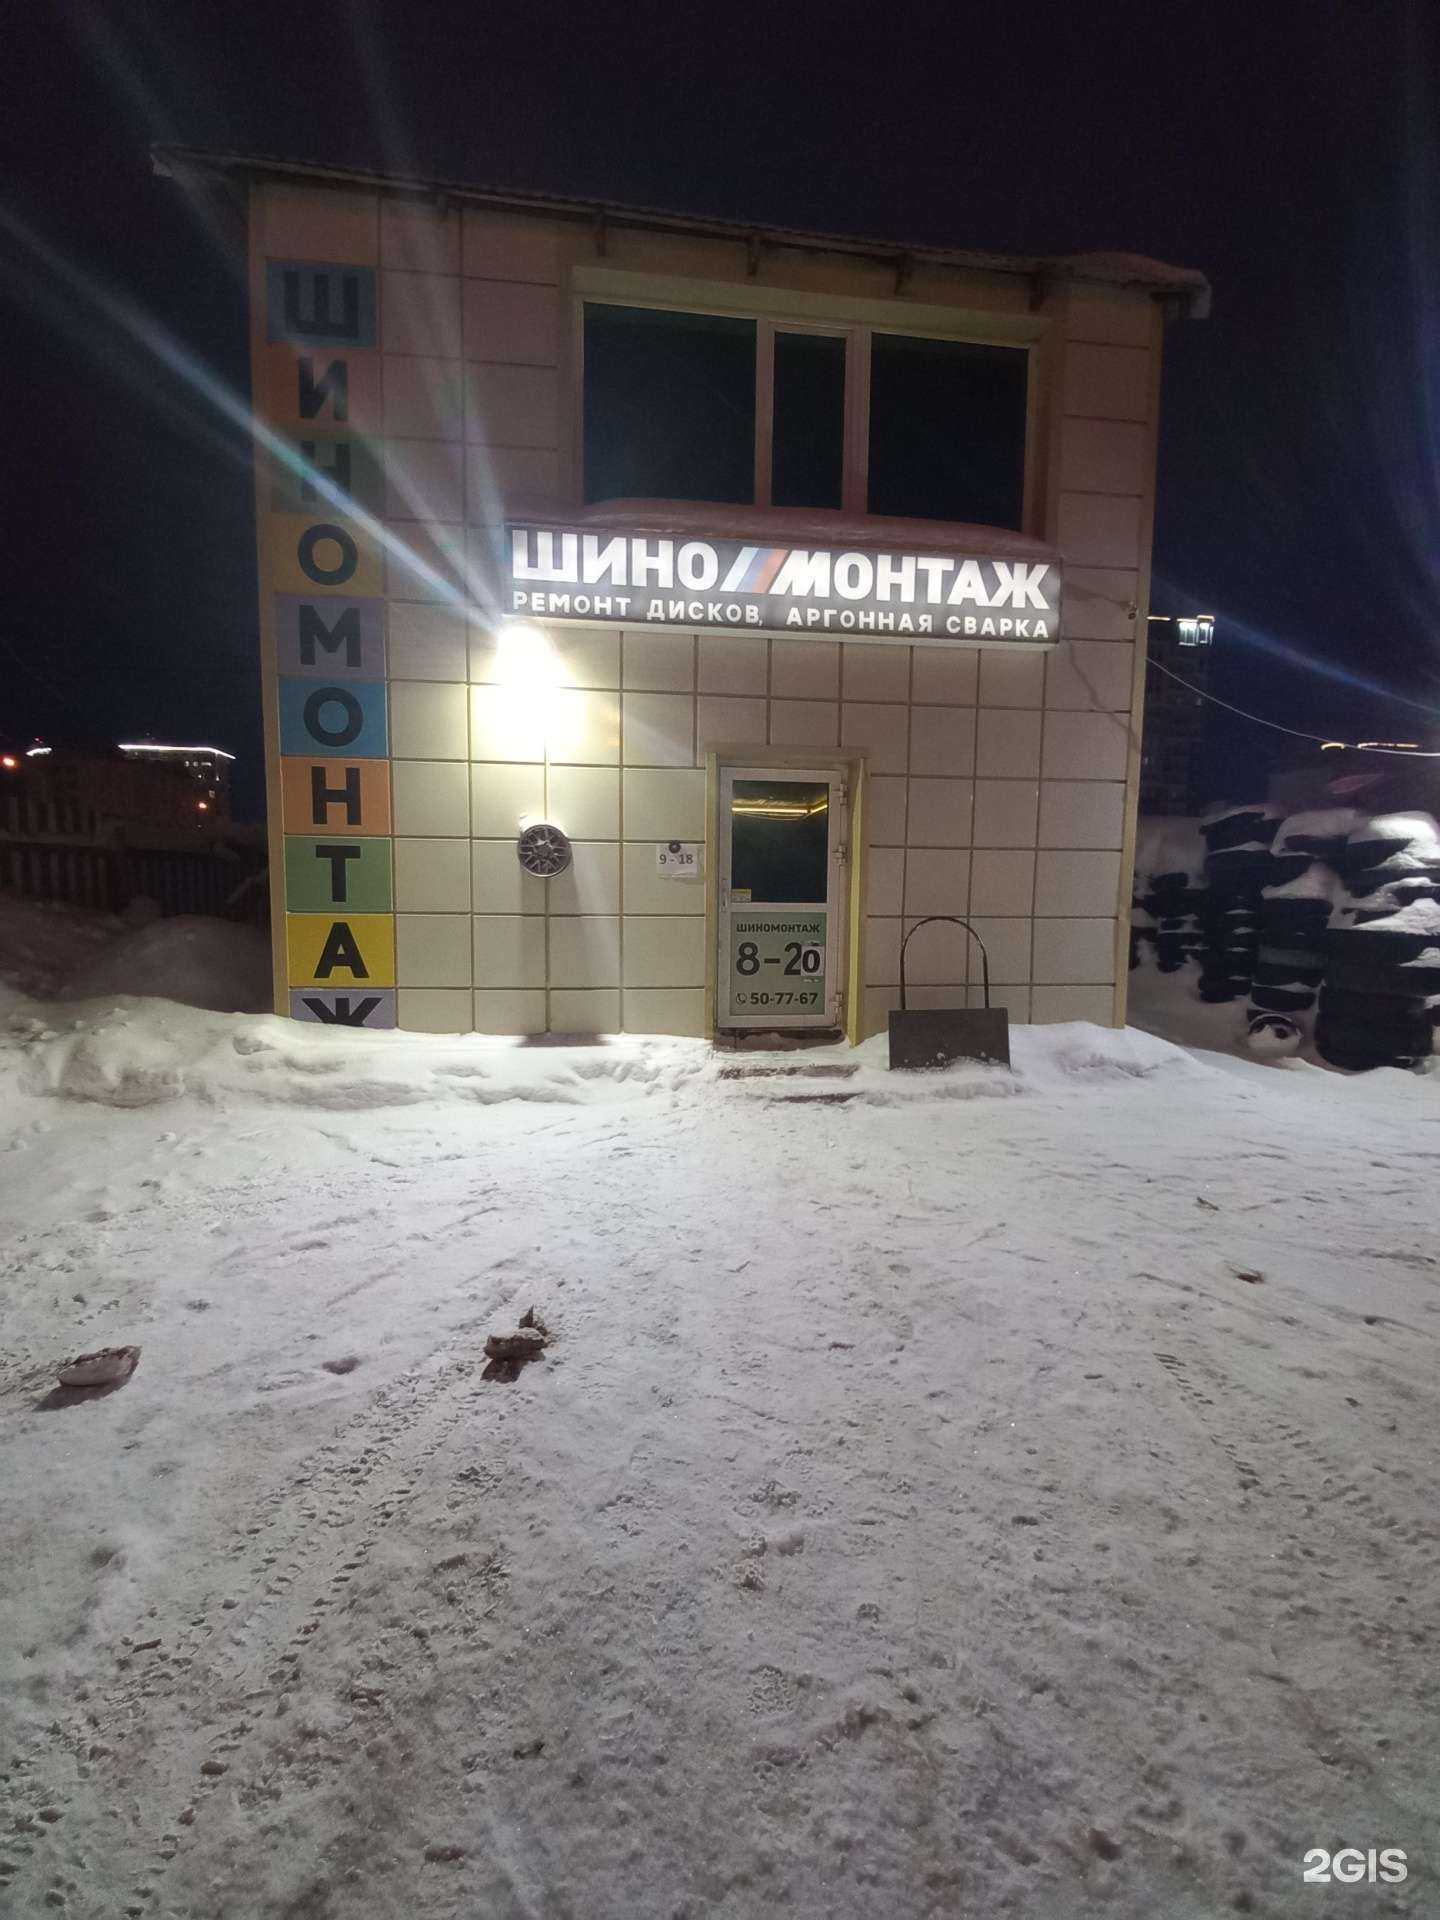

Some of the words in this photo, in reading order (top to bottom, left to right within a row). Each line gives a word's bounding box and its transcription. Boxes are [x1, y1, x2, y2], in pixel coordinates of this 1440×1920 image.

[513, 591, 631, 617] РЕМОНТ
[647, 600, 764, 627] ДИСКОВ,
[785, 607, 933, 634] АРГОННАЯ
[946, 616, 1049, 639] СВАРКА
[659, 854, 667, 864] 9
[678, 854, 693, 864] 18
[736, 923, 820, 933] ШИНОМОНТАЖ
[750, 992, 818, 1005] 50-77-67
